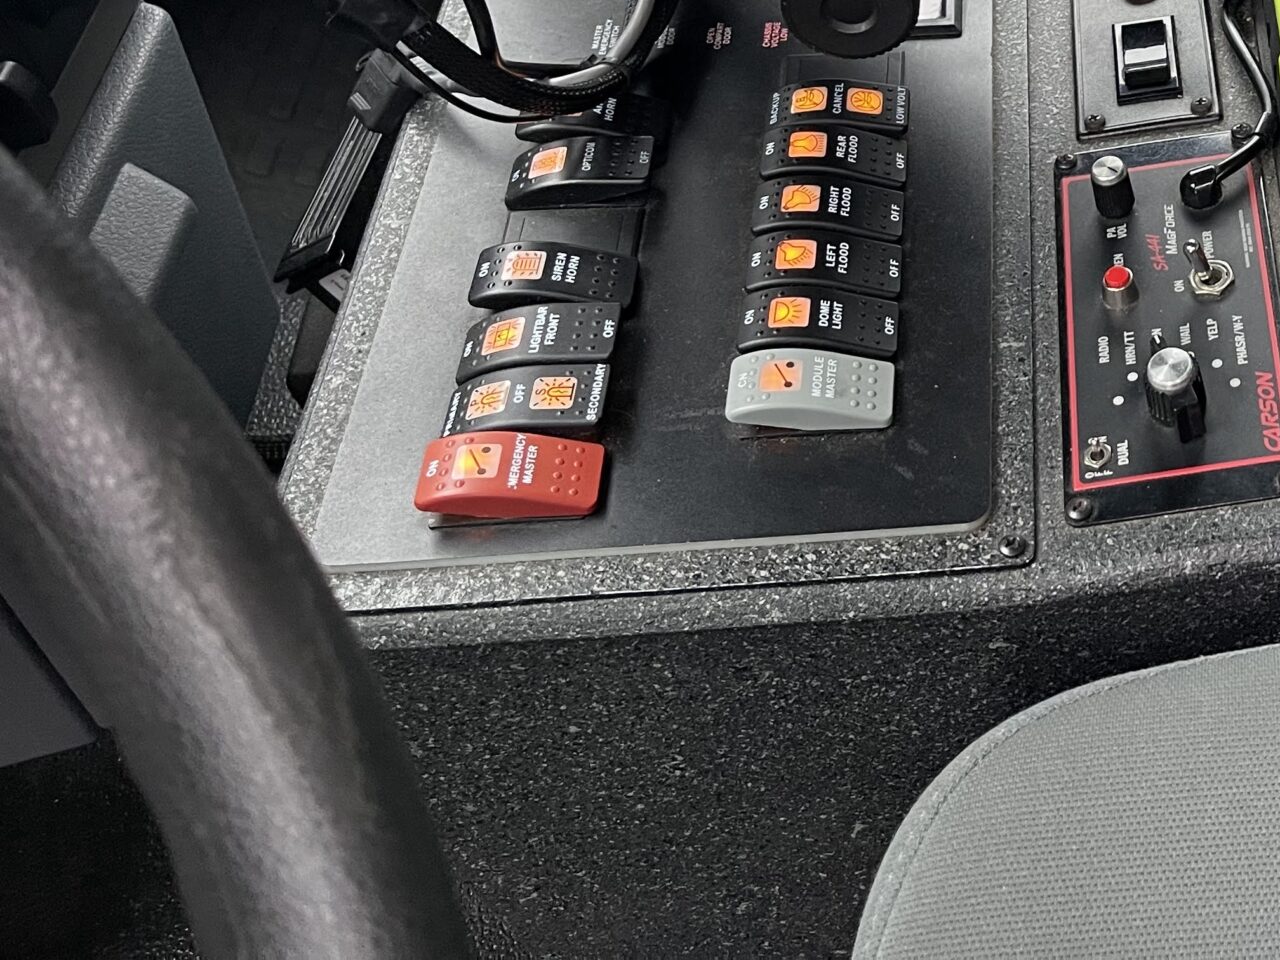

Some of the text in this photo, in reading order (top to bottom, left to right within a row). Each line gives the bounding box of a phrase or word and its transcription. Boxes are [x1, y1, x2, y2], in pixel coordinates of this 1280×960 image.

[591, 25, 603, 49] MASTER
[598, 19, 613, 56] EMERGENCY
[722, 26, 732, 45] DOOR
[762, 22, 773, 48] CHASSIS
[770, 22, 782, 48] VOLTAGE
[780, 28, 788, 41] LOW
[604, 97, 618, 122] HORN
[769, 92, 781, 125] BACKUP
[832, 83, 845, 114] CANCEL
[896, 86, 907, 124] LOW VOLT
[581, 142, 596, 172] OPTICOM
[639, 150, 650, 164] OFF
[765, 141, 776, 156] ON
[836, 135, 847, 158] REAR
[847, 135, 859, 163] FLOOD
[896, 152, 905, 169] OFF
[759, 195, 770, 210] ON
[828, 185, 840, 214] RIGHT
[840, 187, 852, 217] FLOOD
[890, 203, 901, 222] OFF
[1107, 226, 1117, 239] PA
[1117, 223, 1128, 240] VOL
[1202, 230, 1215, 259] POWER
[551, 252, 568, 282] SIREN
[751, 251, 762, 267] ON
[825, 243, 837, 268] LEFT
[837, 242, 850, 274] FLOOD
[889, 258, 900, 278] OFF
[478, 261, 491, 278] ON
[565, 255, 581, 284] HORN
[1174, 279, 1185, 293] ON
[744, 309, 755, 325] ON
[818, 299, 831, 327] DOME
[831, 301, 844, 330] LIGHT
[884, 316, 895, 335] OFF
[527, 305, 549, 354] LIGHTBAR
[543, 313, 560, 346] FRONT
[602, 319, 616, 339] OFF
[1179, 322, 1192, 346] WAIL
[1206, 318, 1219, 341] YELP
[1231, 314, 1249, 366] PHASR/W-Y
[1097, 336, 1110, 364] RADIO
[1123, 331, 1137, 366] HRN/TT
[811, 355, 825, 398] MODULE
[825, 359, 838, 399] MASTER
[513, 383, 526, 404] OFF
[585, 363, 607, 421] SECONDARY
[442, 391, 462, 437] PRIMARY
[522, 445, 539, 485] MASTER
[1116, 439, 1130, 466] DUAL
[426, 459, 440, 478] ON
